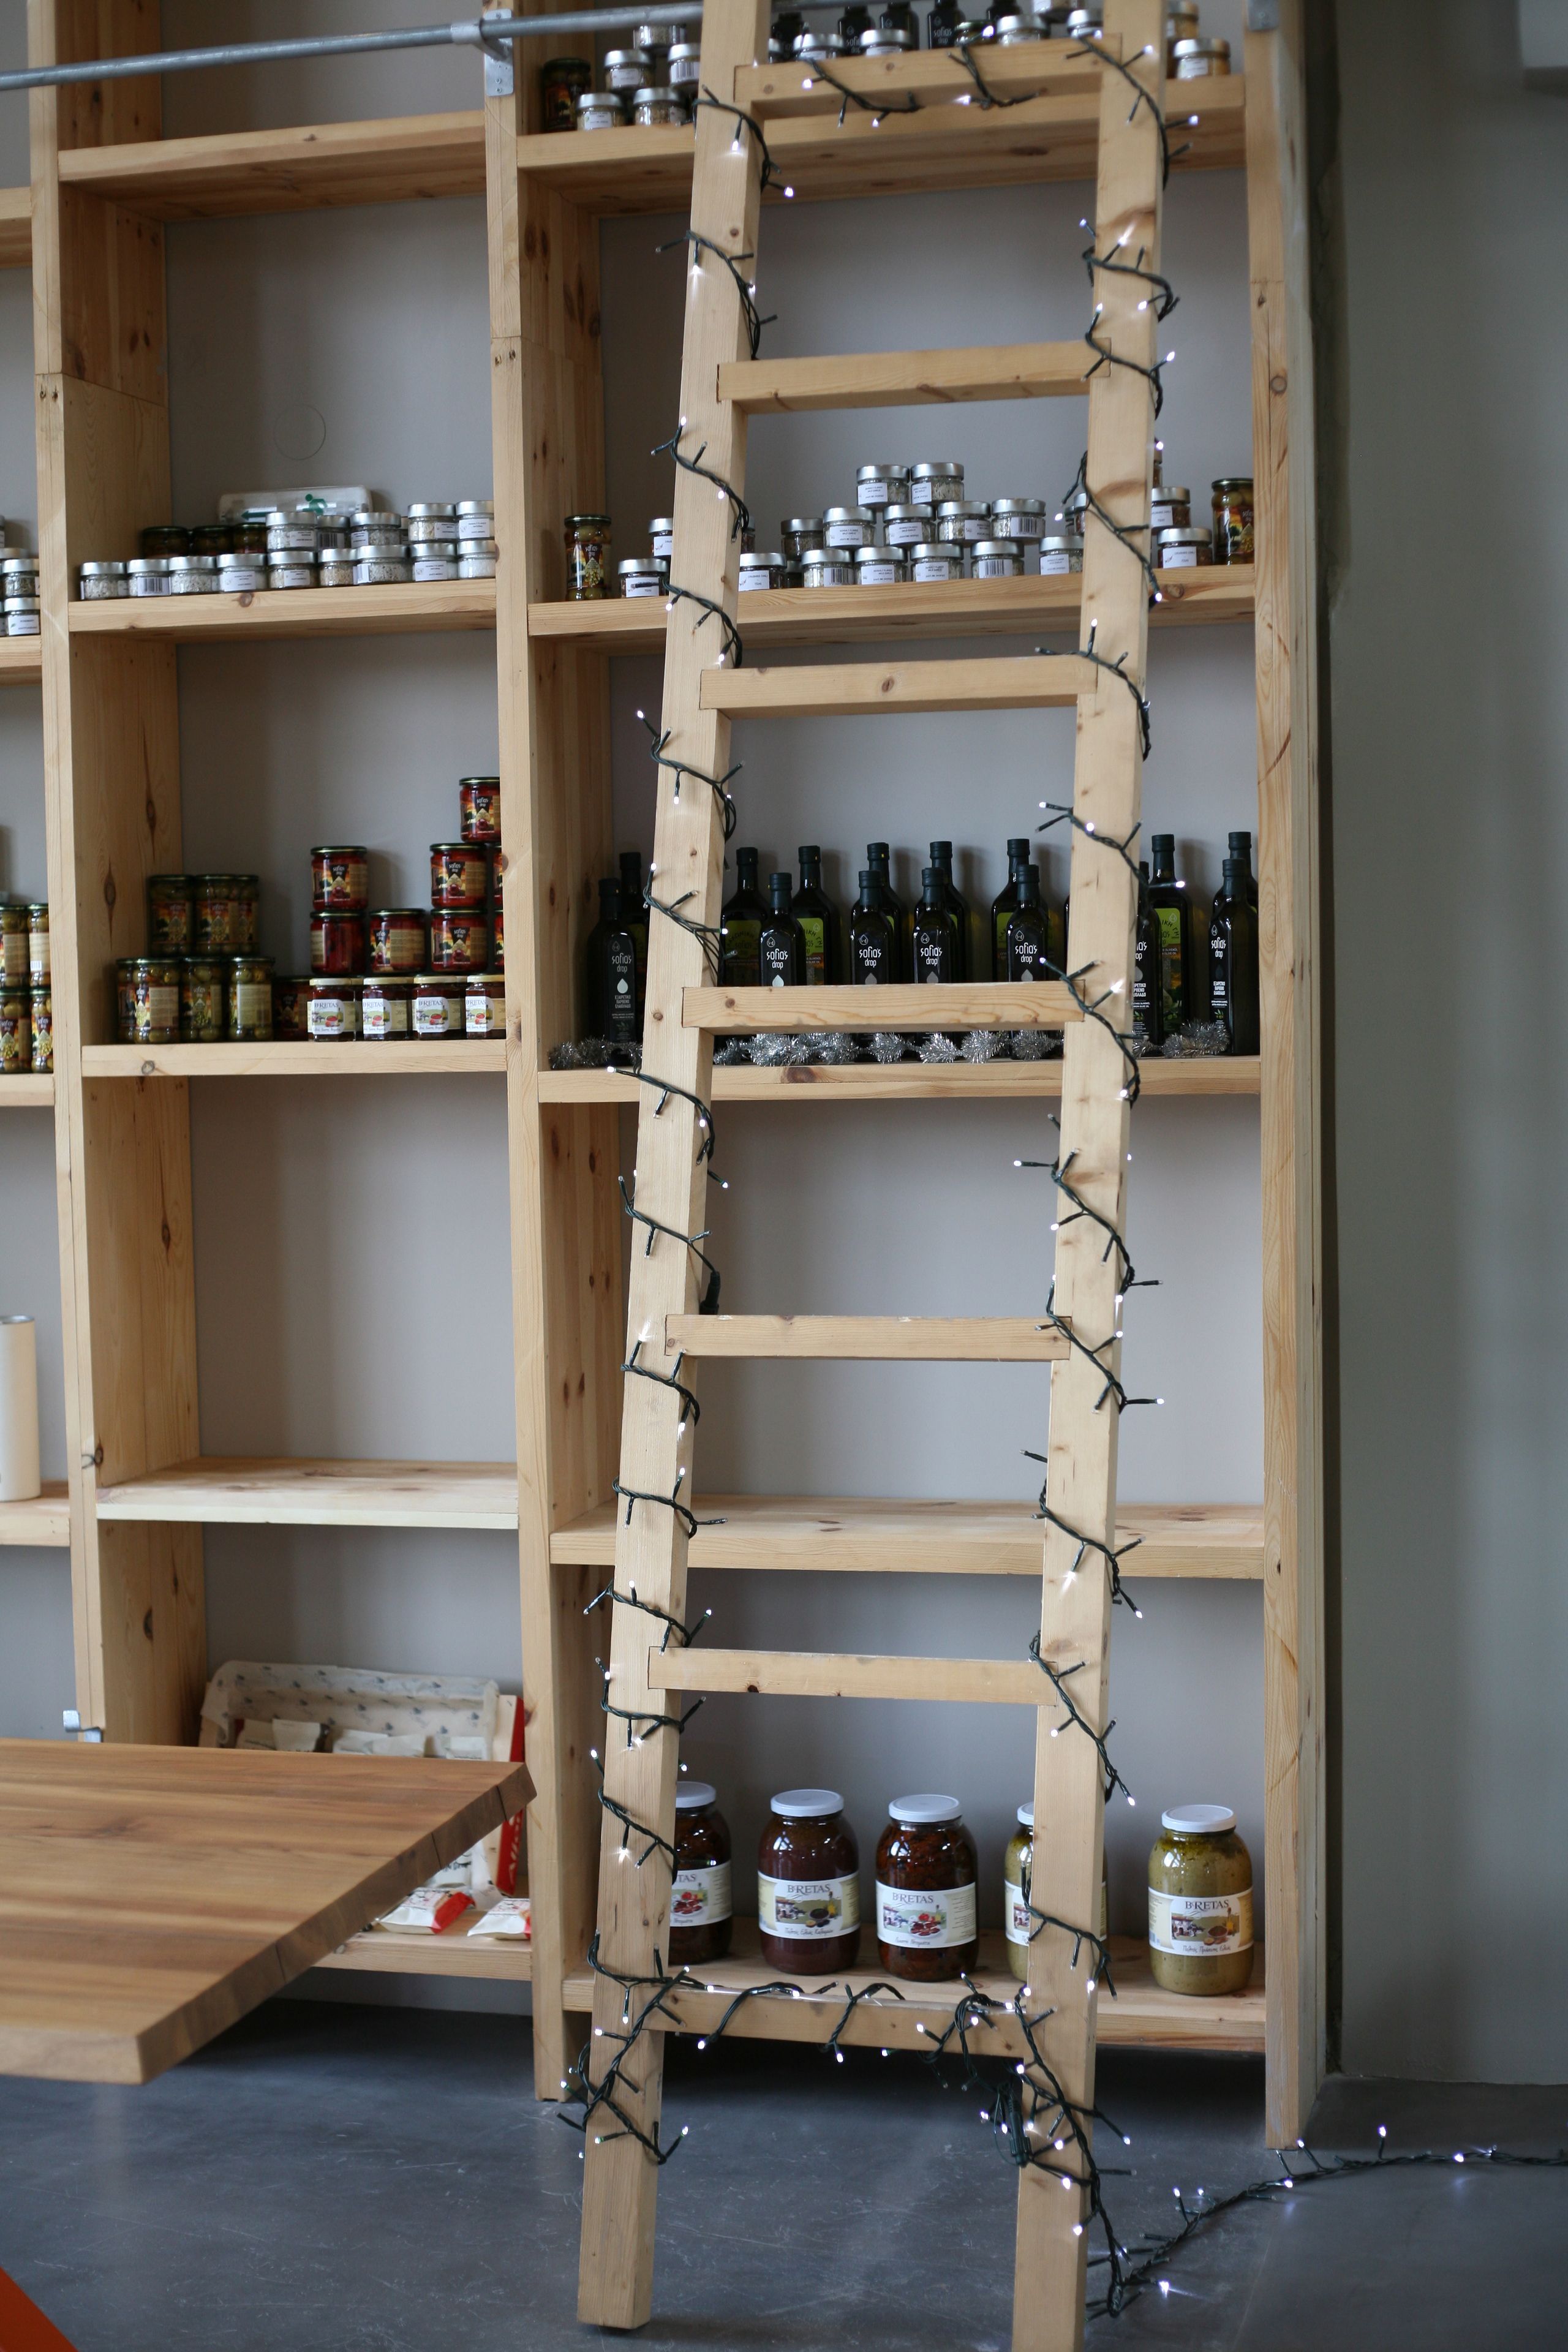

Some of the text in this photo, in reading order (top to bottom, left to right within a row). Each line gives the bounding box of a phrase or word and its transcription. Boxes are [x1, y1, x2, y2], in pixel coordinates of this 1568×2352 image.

[1020, 954, 1033, 964] drop
[1215, 949, 1223, 959] drop
[772, 960, 783, 970] drop
[864, 958, 876, 968] drop
[925, 957, 938, 967] drop
[617, 964, 628, 974] drop
[677, 1874, 696, 1883] TAS
